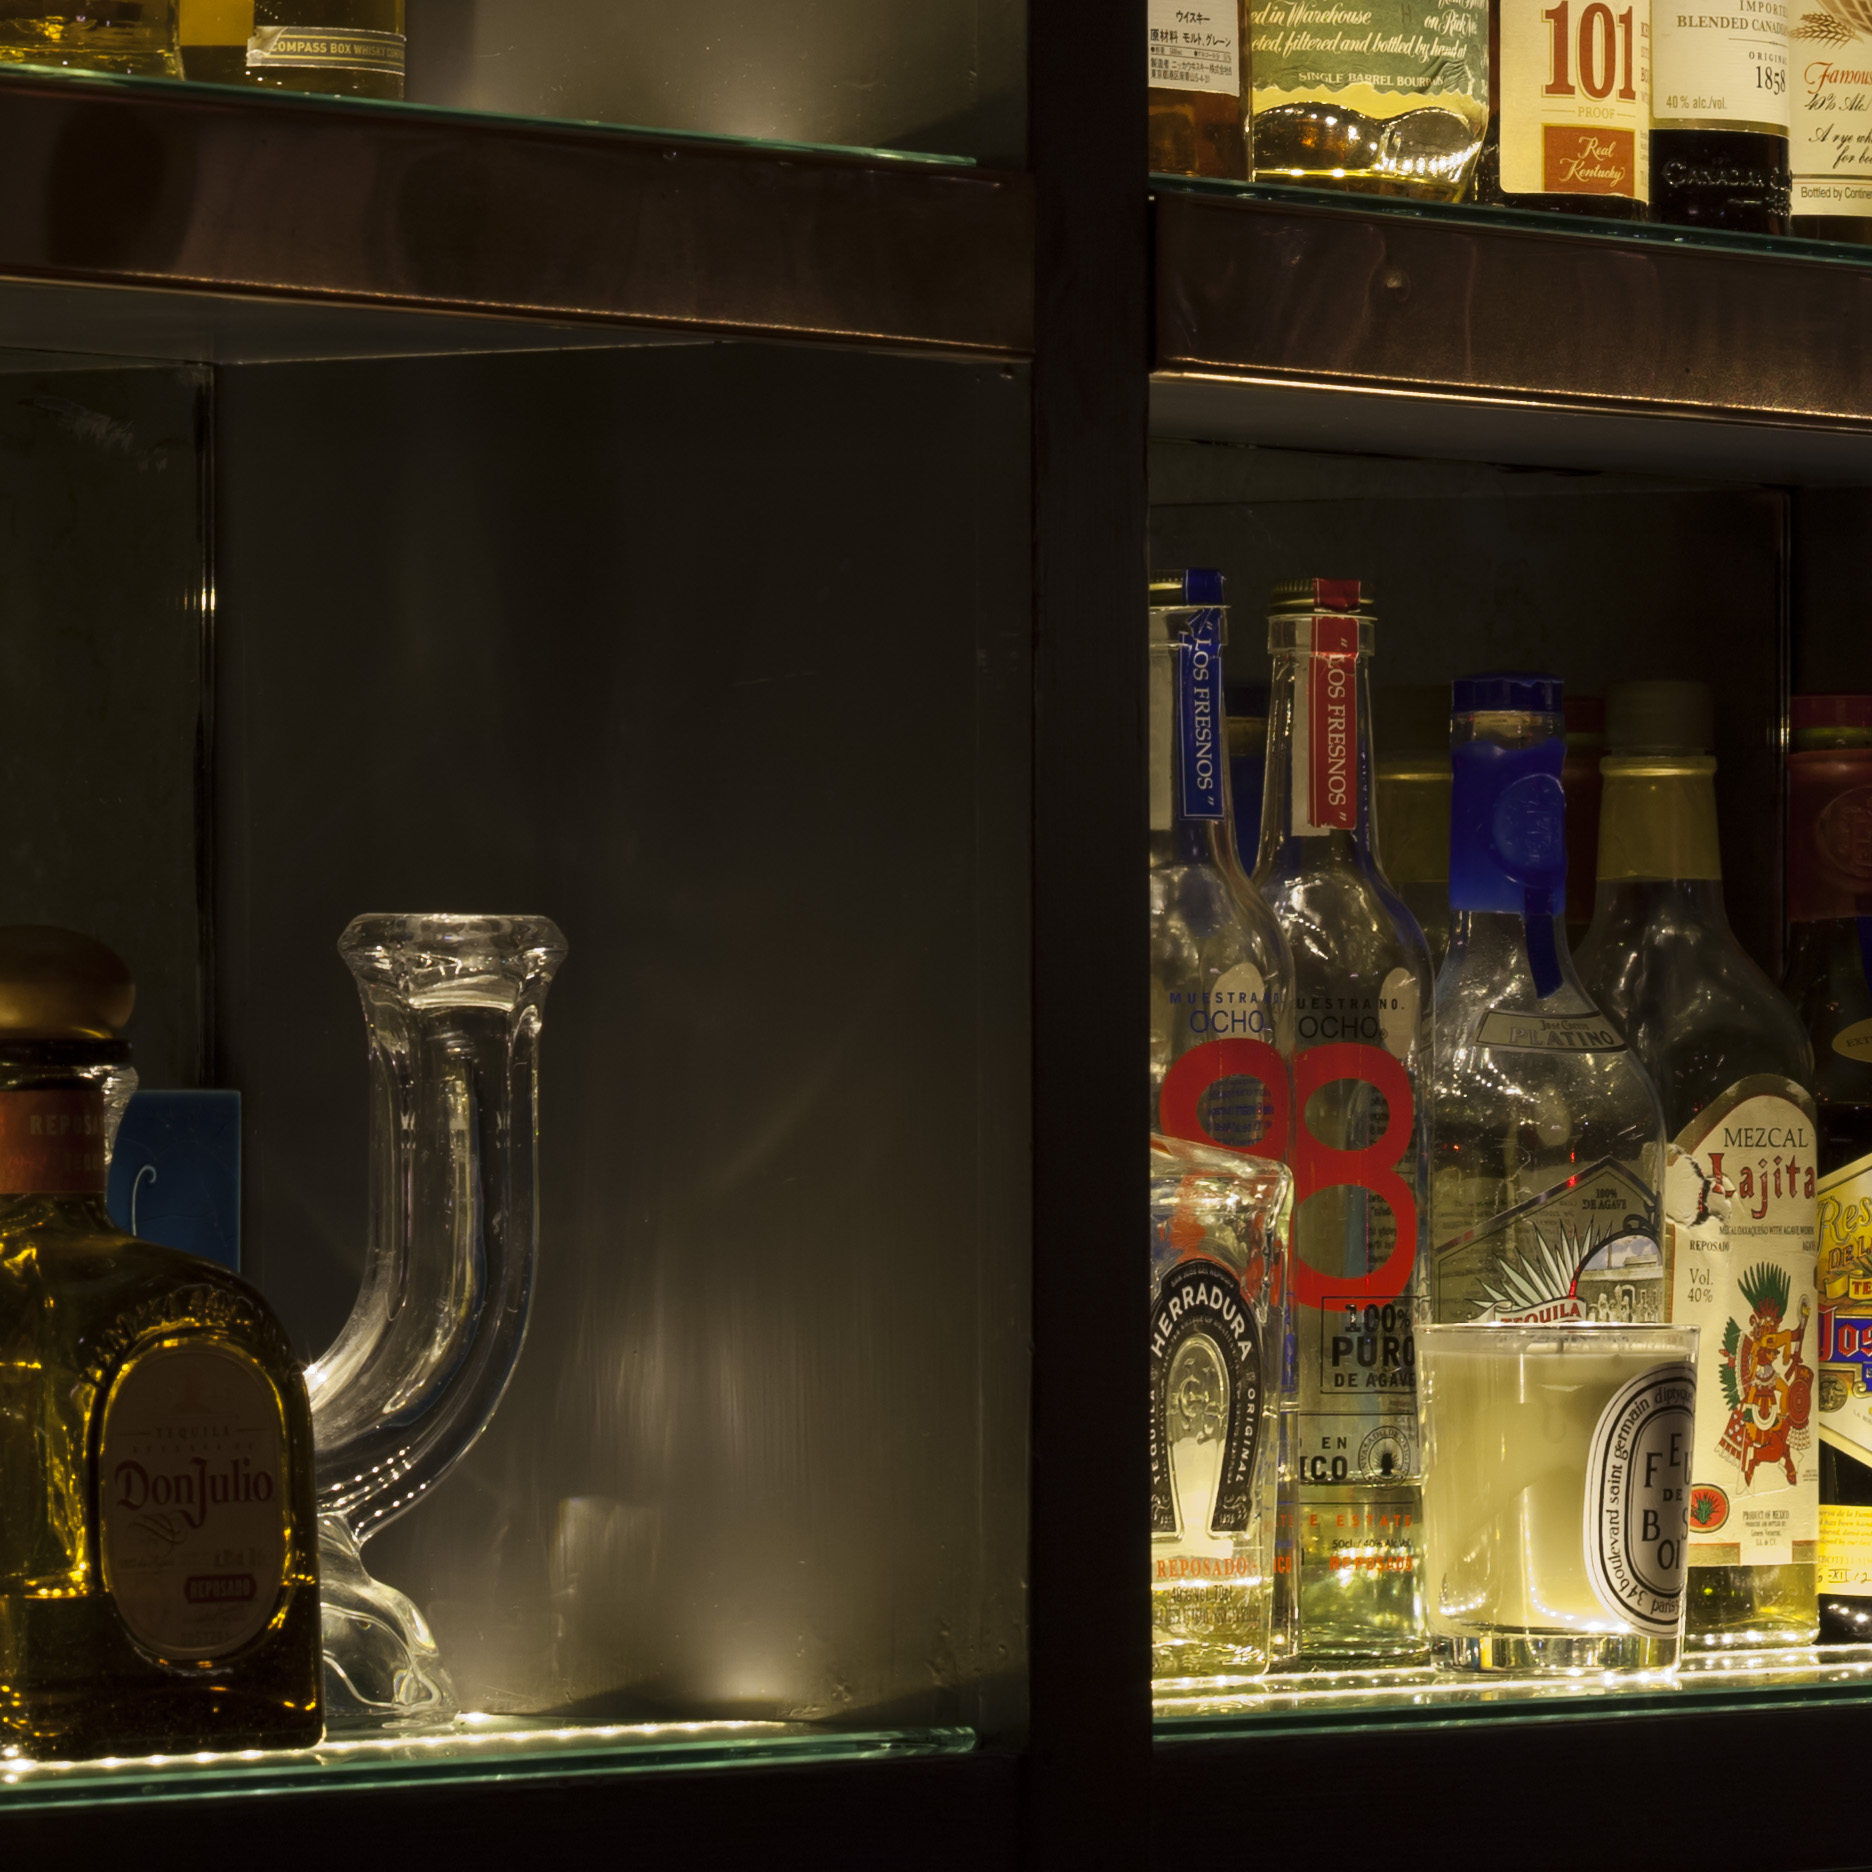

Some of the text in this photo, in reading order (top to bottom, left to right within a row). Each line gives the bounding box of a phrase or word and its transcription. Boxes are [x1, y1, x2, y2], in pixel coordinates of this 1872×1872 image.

[1176, 9, 1211, 25] ウイスキー
[1286, 0, 1373, 29] Warehouse
[1676, 14, 1749, 31] BLENDED
[1150, 28, 1179, 43] 原材料
[1284, 32, 1416, 61] filtered and bottled
[330, 42, 351, 55] BOX
[1541, 0, 1638, 102] 101
[1299, 71, 1394, 86] SINGLE BARREL
[1756, 65, 1786, 97] 1858
[1577, 106, 1616, 120] PROOF
[1804, 93, 1836, 111] 40%
[1578, 135, 1614, 158] Real
[1832, 132, 1854, 150] rye
[1832, 145, 1855, 169] for
[1558, 159, 1626, 189] Kentucky
[1801, 186, 1832, 200] Bottled
[1193, 635, 1215, 792] LOS FRESNOS
[1326, 653, 1348, 810] LOS FRESNOS
[1169, 991, 1258, 1004] MUESTRA
[1189, 1009, 1266, 1034] OCHO
[1508, 1024, 1616, 1048] PLATINO
[1723, 1127, 1809, 1149] MEZCAL
[1291, 1042, 1418, 1312] 8
[1689, 1267, 1715, 1286] Vol.
[1687, 1288, 1714, 1305] 40%
[1150, 1282, 1253, 1362] HERRADURA
[1344, 1301, 1412, 1334] 100%
[1331, 1335, 1416, 1368] PURO
[1365, 1372, 1416, 1389] AGAVE
[1235, 1386, 1256, 1483] ORIGINAL
[1605, 1399, 1651, 1594] boulevard saint germain
[1156, 1555, 1248, 1579] REPOSADO
[188, 1579, 251, 1600] REPOSADO
